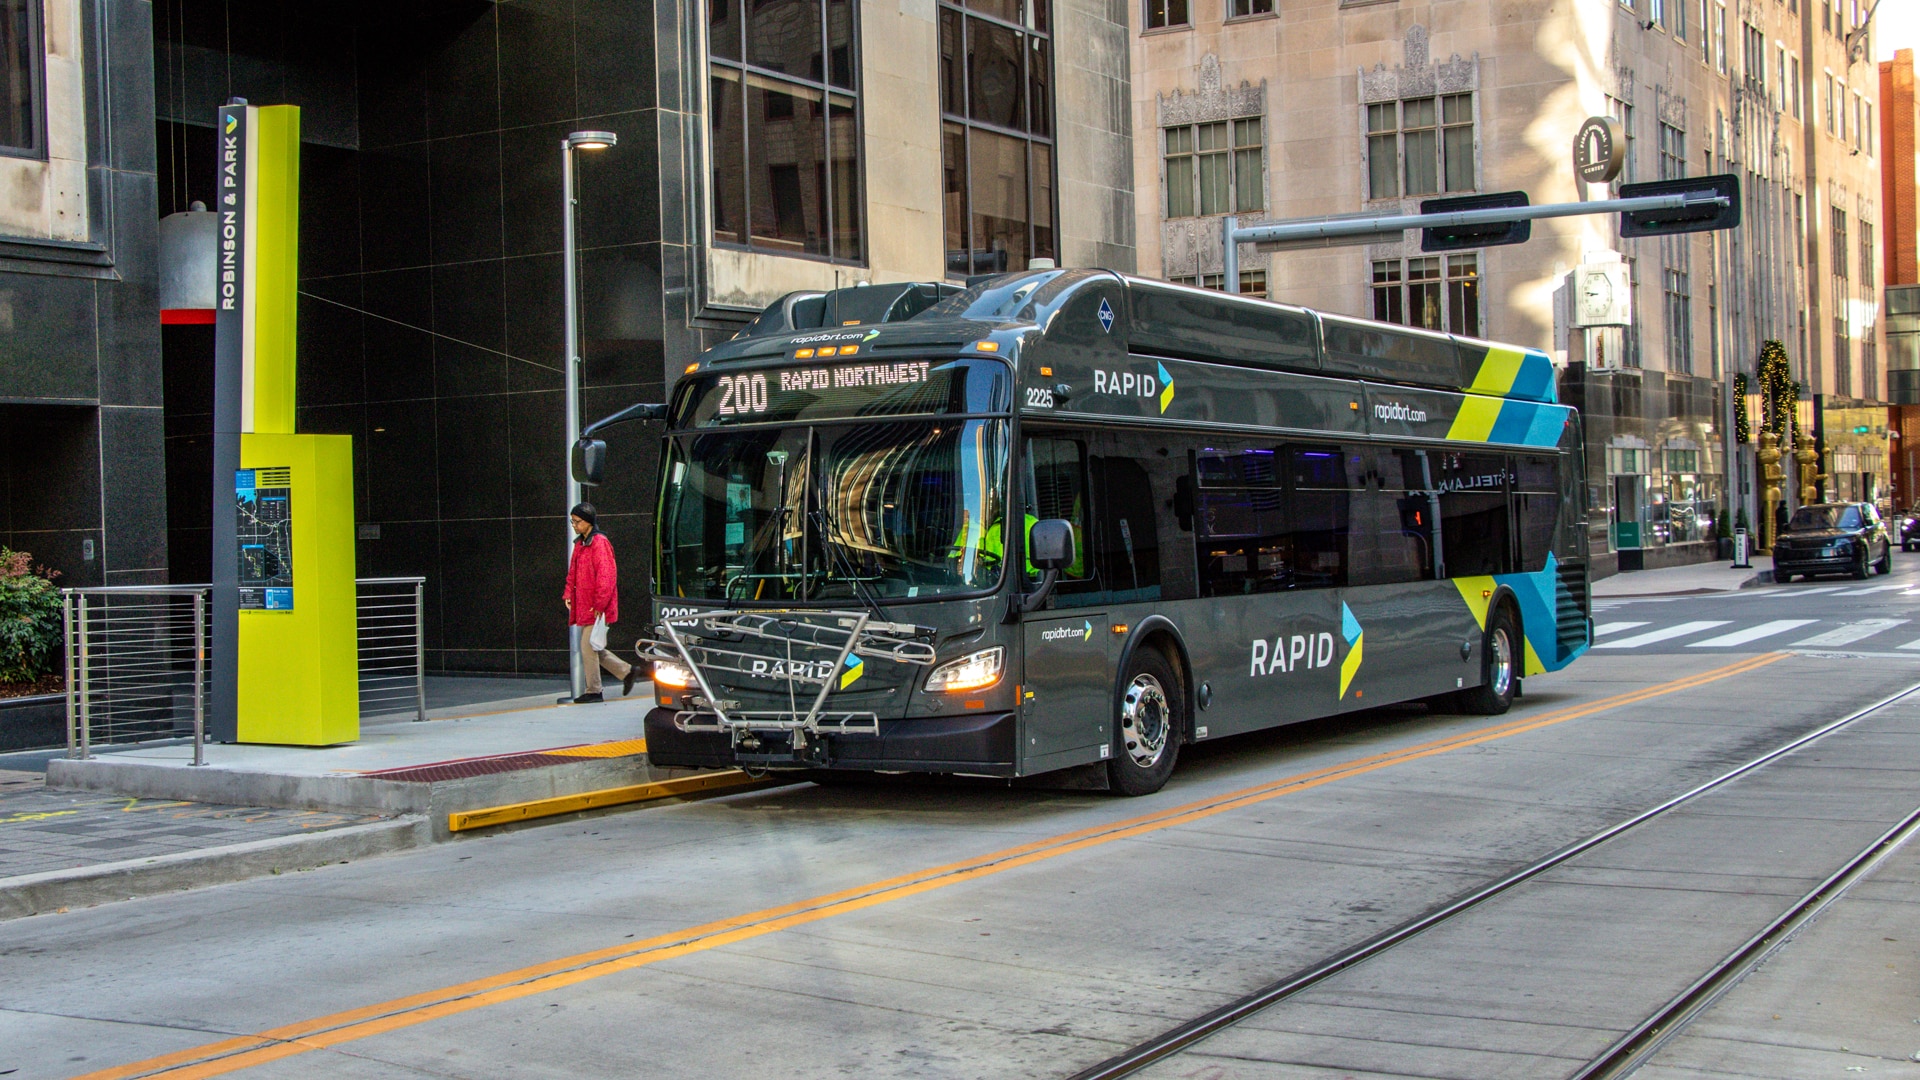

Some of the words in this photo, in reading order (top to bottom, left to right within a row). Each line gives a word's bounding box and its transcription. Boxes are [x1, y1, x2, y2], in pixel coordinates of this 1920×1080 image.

[1588, 124, 1607, 142] NATIONAL
[224, 136, 237, 188] PARK
[1584, 164, 1604, 173] CENTER
[224, 192, 236, 206] &
[222, 211, 236, 310] ROBINSON
[1100, 310, 1112, 321] CNG
[790, 332, 864, 344] rapidbrt.com
[780, 369, 829, 391] RAPID
[834, 362, 930, 387] NORTHWEST
[1094, 369, 1156, 398] RAPID
[718, 374, 767, 415] 200
[1026, 387, 1054, 408] 2225
[1374, 402, 1427, 423] rapidbrt.com
[1042, 627, 1084, 642] rapidbrt.com
[1250, 632, 1334, 677] RAPID
[751, 660, 835, 678] RAPID
